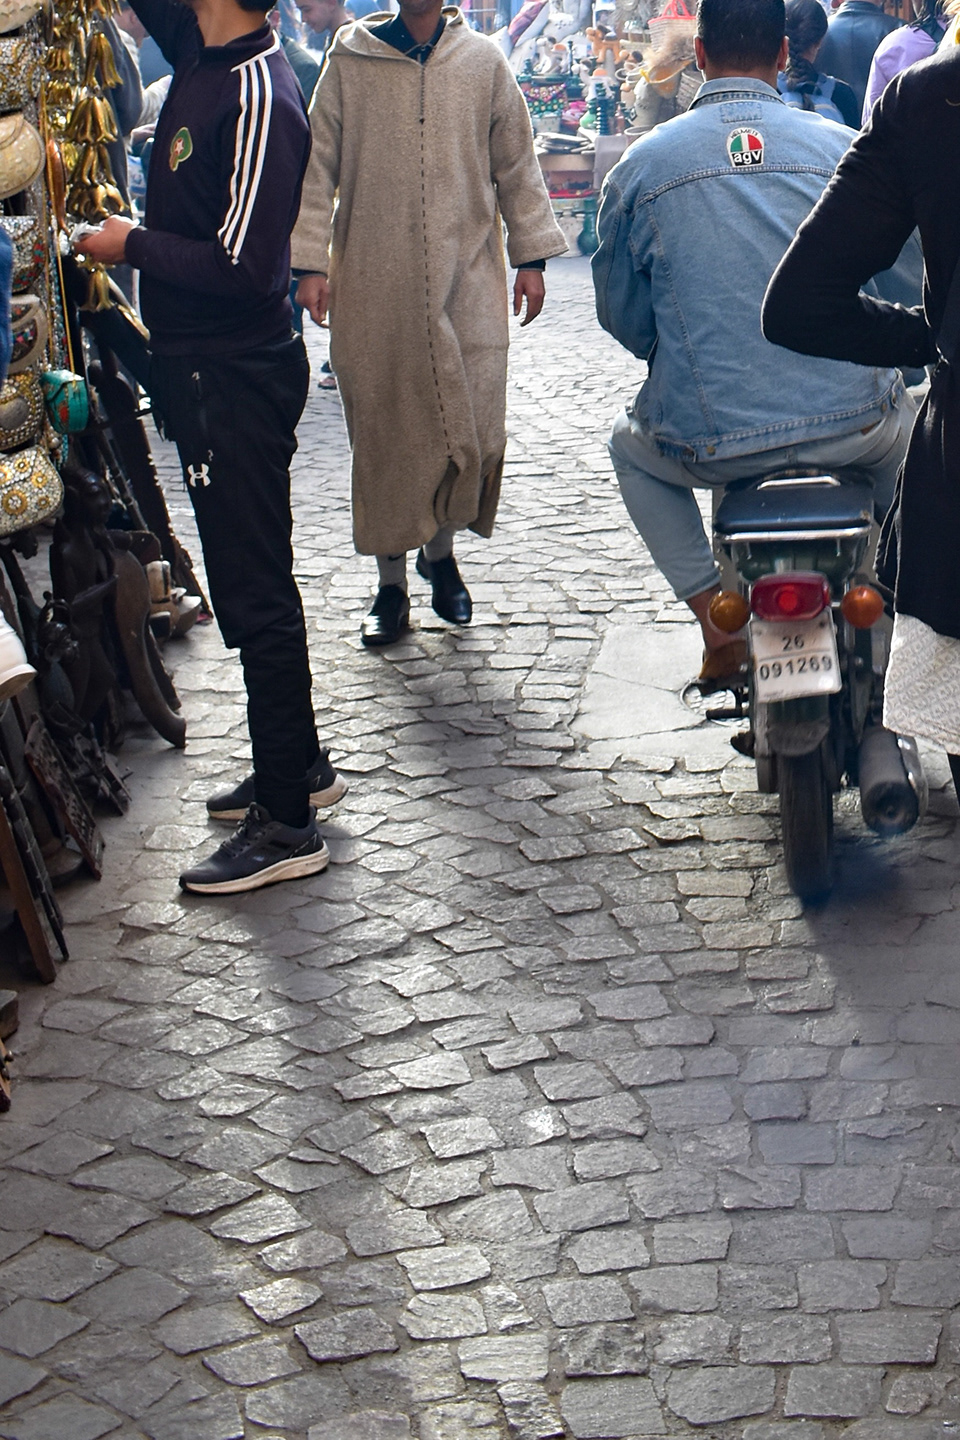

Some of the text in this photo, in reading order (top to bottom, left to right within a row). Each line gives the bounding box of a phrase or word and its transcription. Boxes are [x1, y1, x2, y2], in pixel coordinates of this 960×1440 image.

[734, 151, 761, 164] agv
[782, 634, 805, 651] 26
[759, 655, 833, 681] 091269
